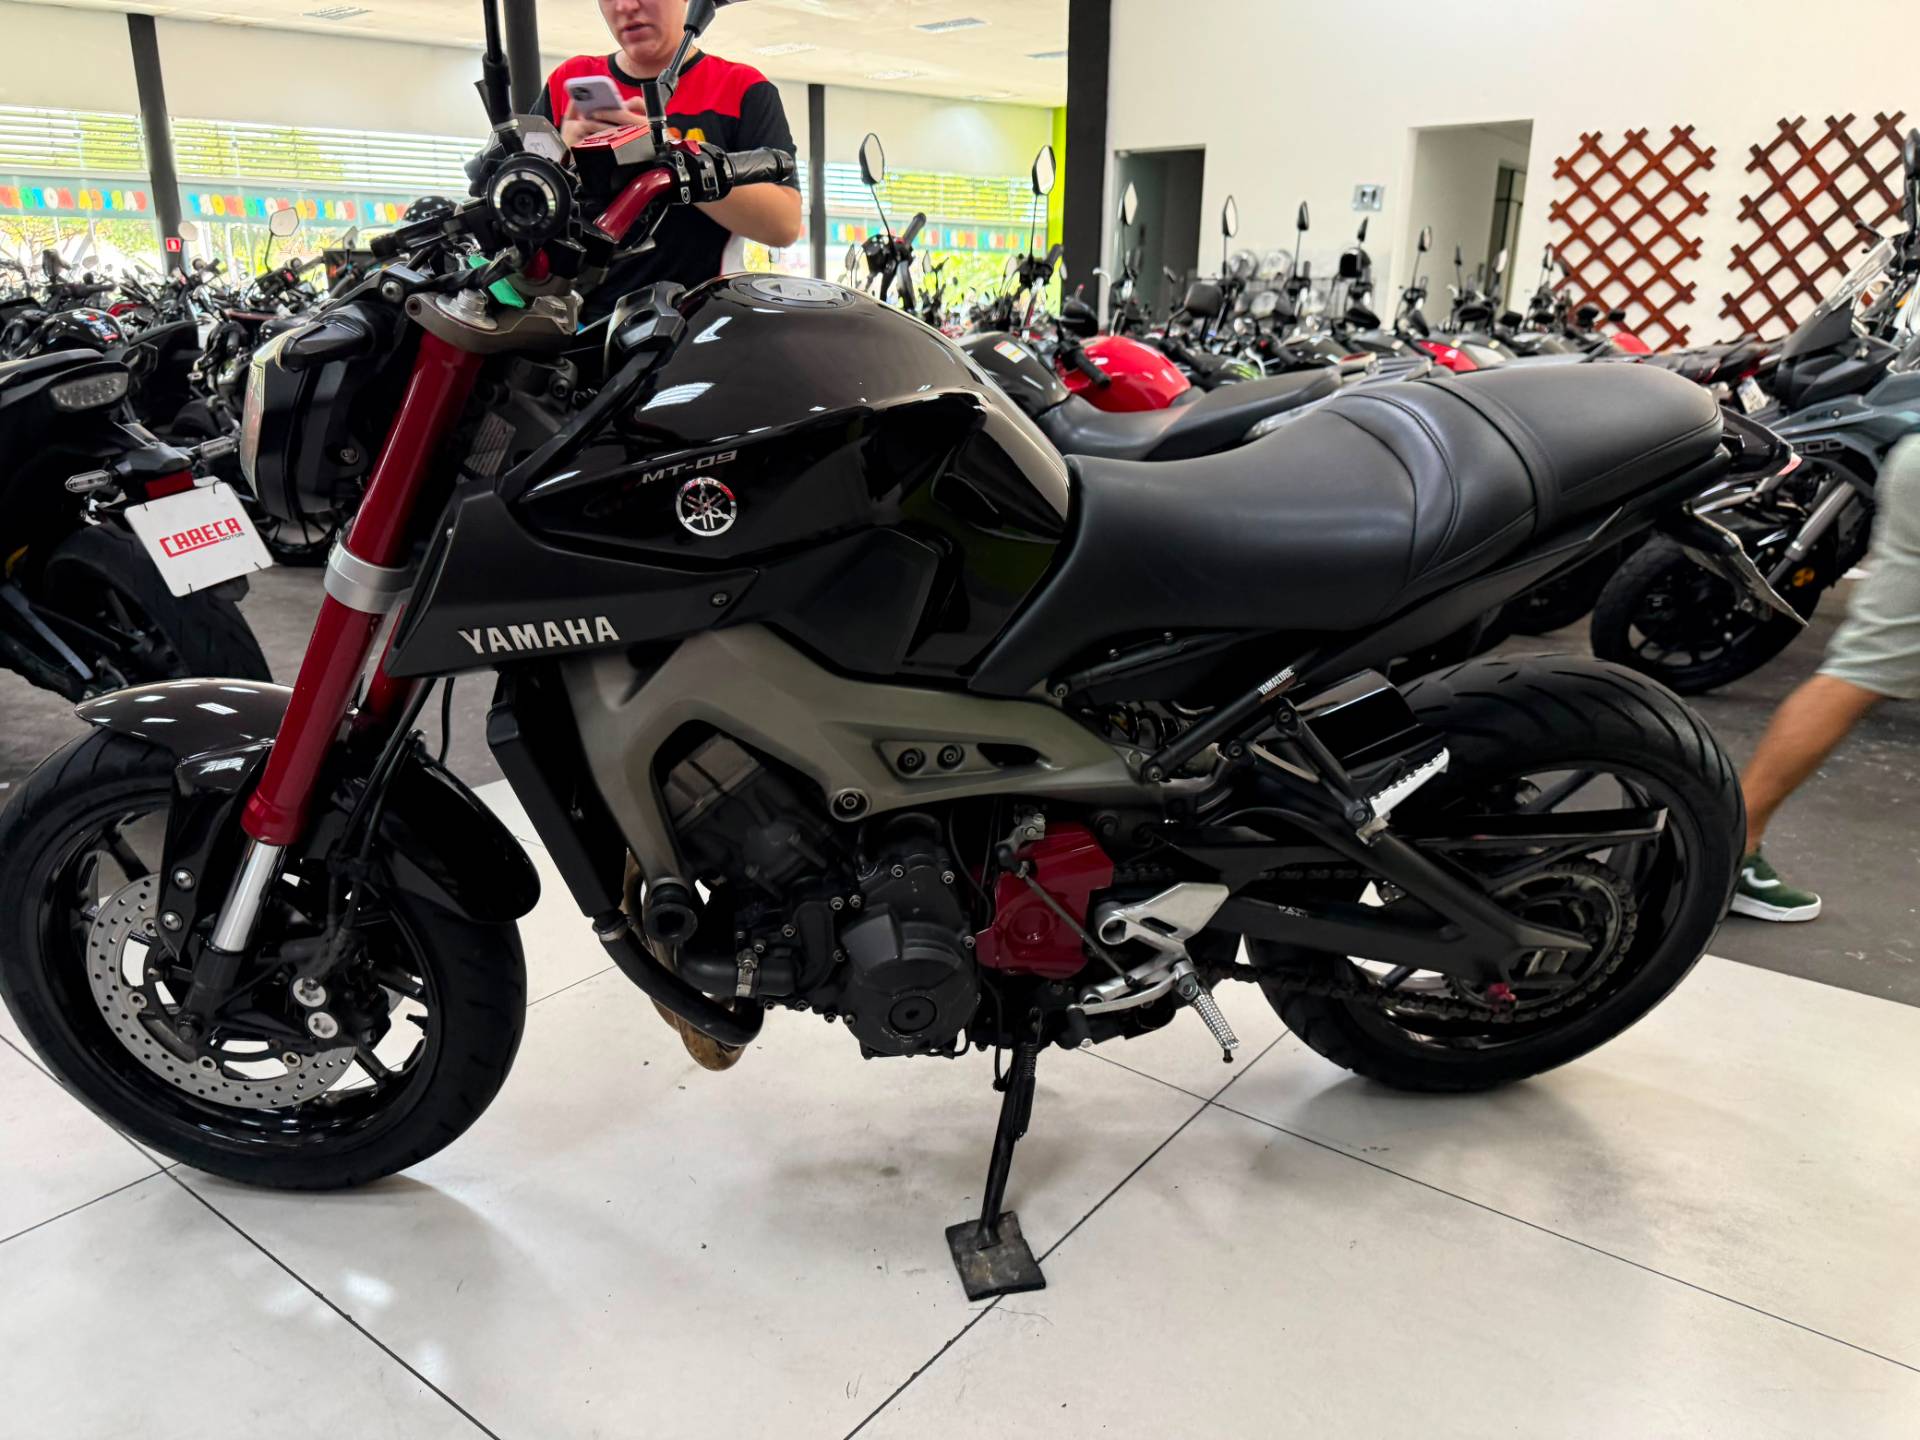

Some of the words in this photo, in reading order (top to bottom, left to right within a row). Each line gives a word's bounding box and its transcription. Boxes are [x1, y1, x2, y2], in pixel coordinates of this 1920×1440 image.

[641, 449, 738, 484] MT-09
[159, 517, 242, 558] CARECA
[457, 615, 621, 655] YAMAHA
[1257, 664, 1296, 696] YAMALUBE
